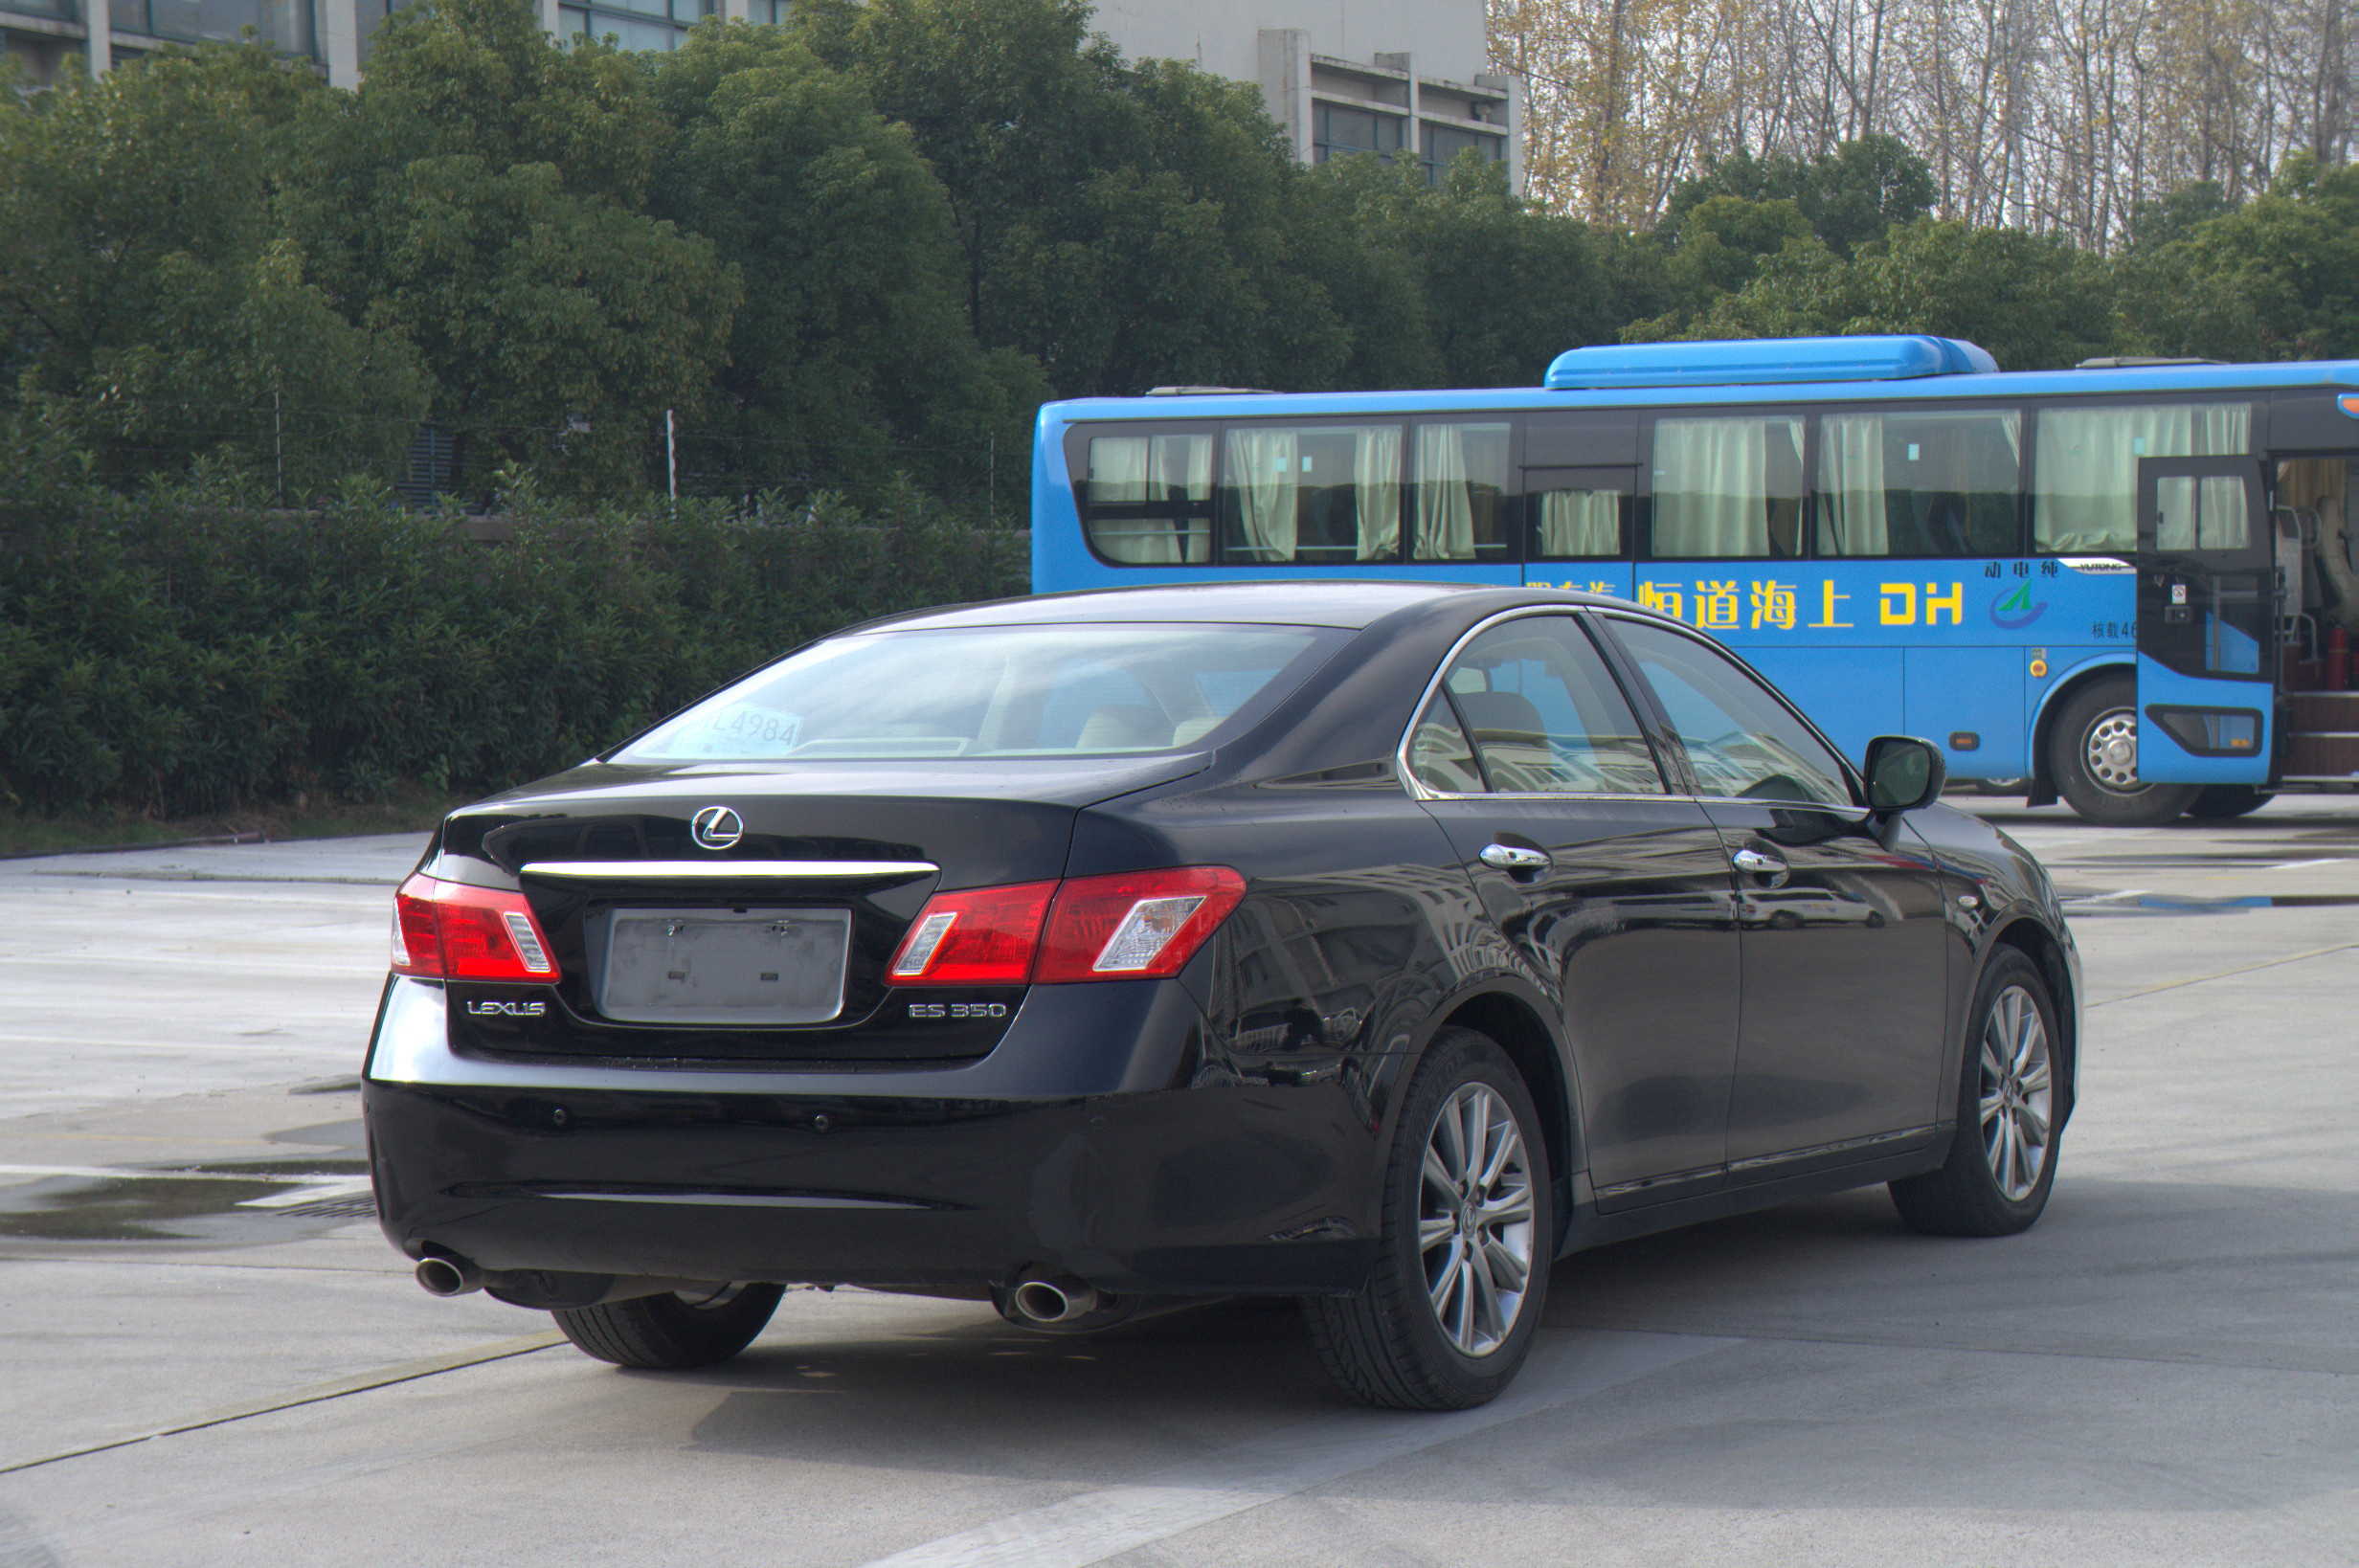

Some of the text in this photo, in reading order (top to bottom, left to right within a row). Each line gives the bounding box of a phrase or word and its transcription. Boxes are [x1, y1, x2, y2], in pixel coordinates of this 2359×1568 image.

[2079, 562, 2123, 571] YUTONG
[466, 1000, 546, 1017] LEXUS
[909, 1003, 1007, 1018] ES 350
